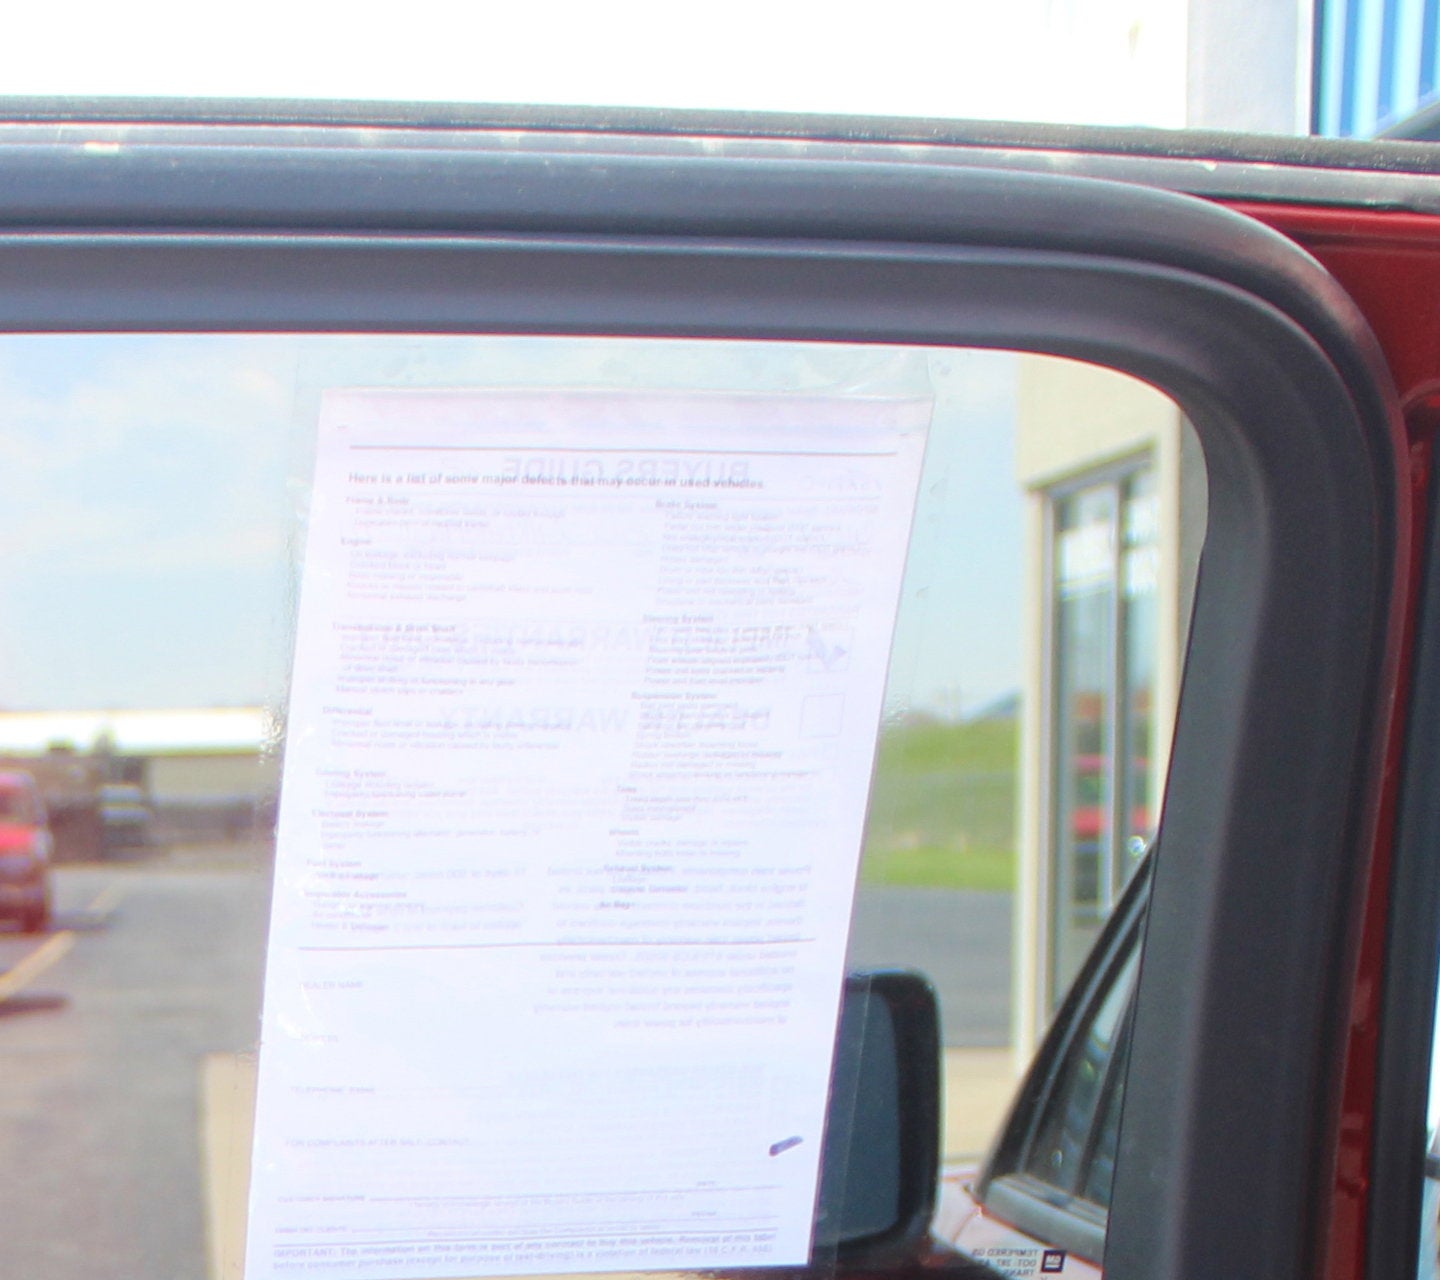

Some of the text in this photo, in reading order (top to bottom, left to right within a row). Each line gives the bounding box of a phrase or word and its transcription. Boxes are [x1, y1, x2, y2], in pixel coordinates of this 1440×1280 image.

[348, 472, 377, 484] Here
[381, 473, 391, 484] is
[395, 475, 404, 484] a
[406, 472, 425, 484] list
[429, 473, 443, 485] of
[445, 475, 478, 485] some
[482, 474, 517, 487] major
[521, 474, 567, 486] defects
[571, 474, 594, 486] that
[598, 477, 622, 489] may
[626, 478, 661, 487] occur
[664, 477, 676, 487] in
[680, 476, 710, 488] used
